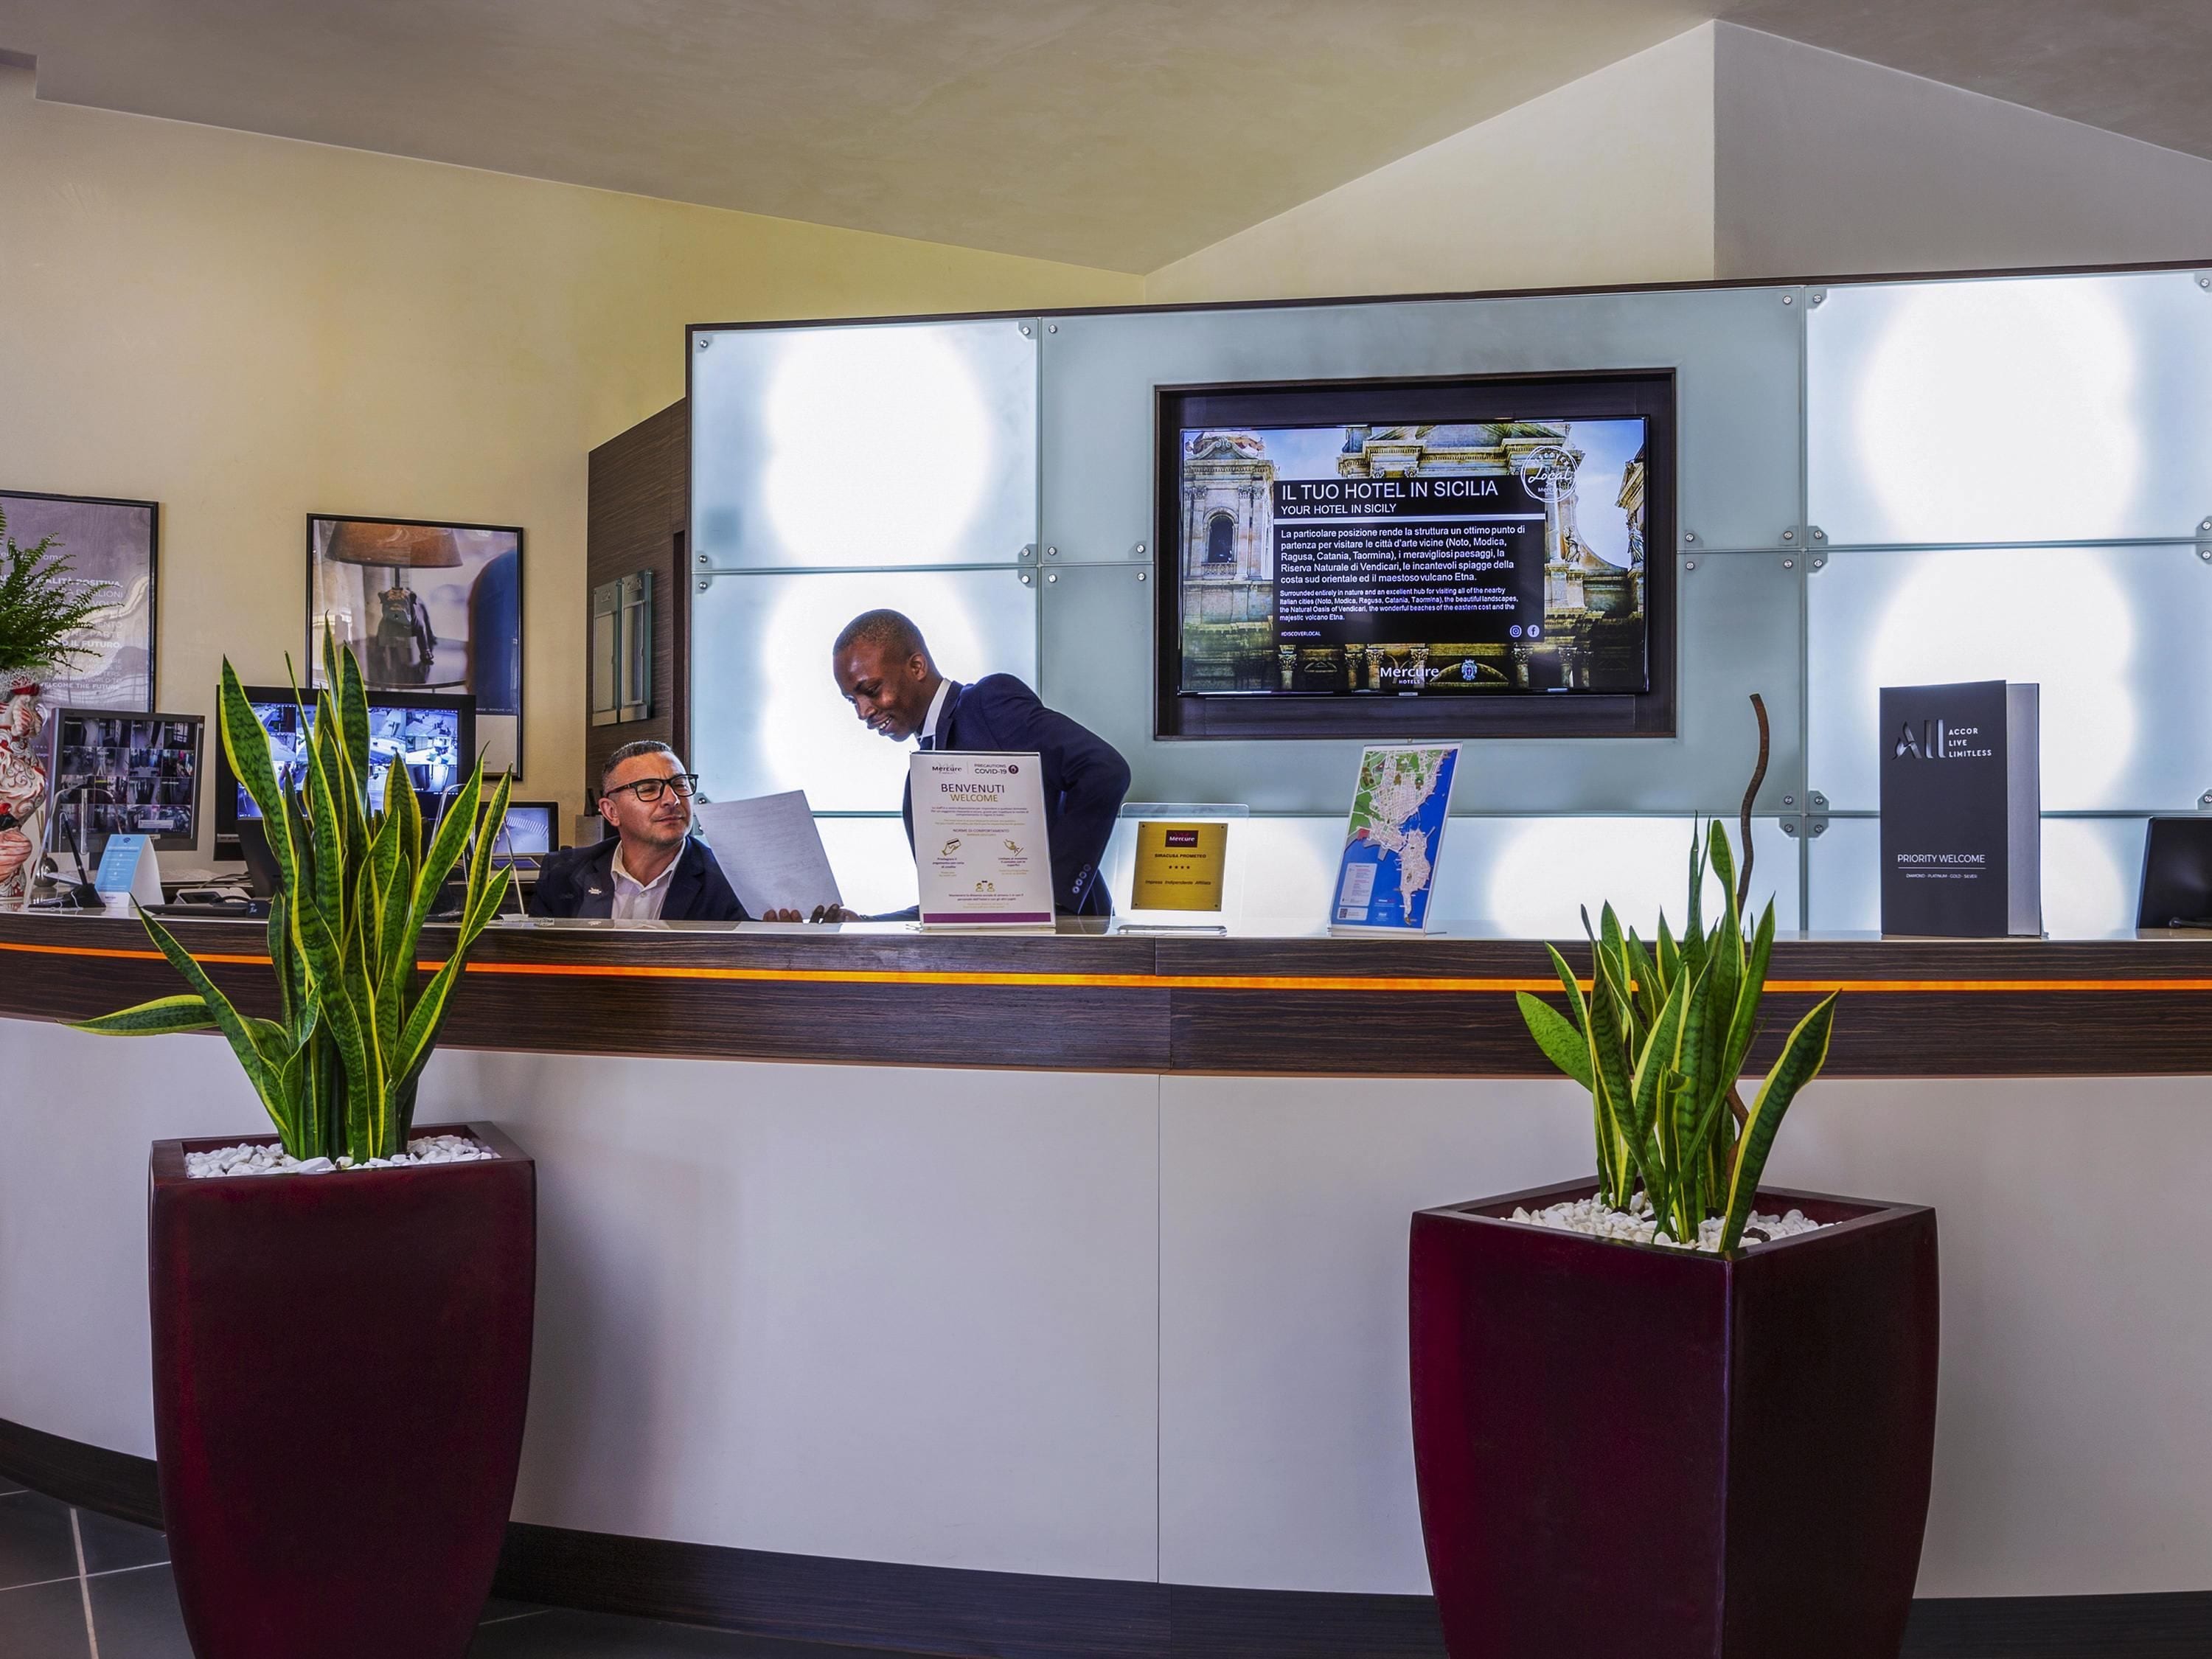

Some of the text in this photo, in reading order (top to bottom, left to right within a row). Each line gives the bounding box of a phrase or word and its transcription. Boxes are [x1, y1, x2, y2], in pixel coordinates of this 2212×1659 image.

[1528, 465, 1573, 483] Local
[1282, 480, 1498, 500] IL TUO HOTEL IN SICILIA
[1281, 504, 1397, 515] YOUR HOTEL IN SICILY
[1281, 529, 1291, 538] La
[1293, 529, 1336, 539] particolare
[1338, 529, 1377, 538] posizione
[1379, 528, 1402, 537] rende
[1405, 528, 1413, 536] la
[1414, 526, 1449, 536] struttura
[1464, 526, 1490, 535] ottimo
[1492, 526, 1515, 535] punto
[1517, 525, 1525, 534] di
[1281, 542, 1316, 551] partenza
[1318, 542, 1332, 551] per
[1334, 540, 1363, 549] visitare
[1366, 540, 1373, 548] le
[1375, 539, 1393, 548] città
[1419, 538, 1443, 547] vicine
[1446, 538, 1471, 548] (Noto,
[1474, 538, 1507, 548] Modica,
[1281, 552, 1315, 563] Ragusa,
[1317, 552, 1352, 561] Catania,
[1352, 551, 1397, 560] Taormina),
[1403, 550, 1453, 560] meravigliosi
[1454, 549, 1495, 560] paesaggi,
[1497, 549, 1504, 557] la
[1281, 560, 1514, 572] Riserva Naturale di Vendicari, le incantevoli spiagge della
[1321, 574, 1357, 582] orientale
[1420, 573, 1453, 581] vulcano
[1455, 572, 1477, 581] Etna.
[82, 640, 122, 649] FUTURO.
[1380, 667, 1439, 678] Mercure
[1948, 728, 1978, 736] ACCOR
[1949, 749, 1992, 758] LIMITLESS
[941, 783, 1004, 793] BENVENUTI
[950, 794, 998, 802] WELCOME
[1897, 855, 1986, 863] PRIORITY WELCOME
